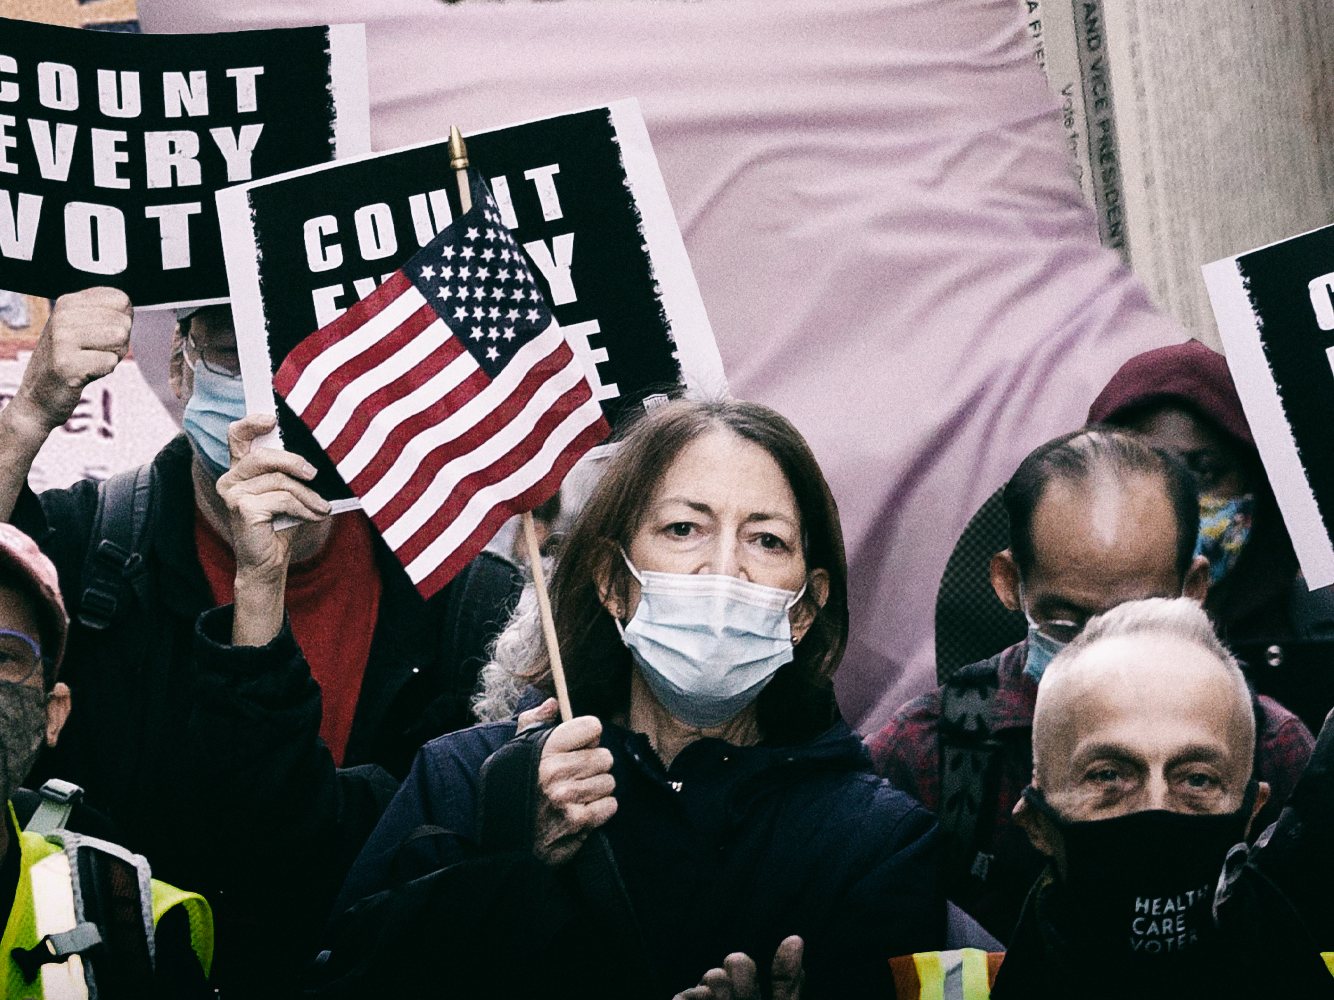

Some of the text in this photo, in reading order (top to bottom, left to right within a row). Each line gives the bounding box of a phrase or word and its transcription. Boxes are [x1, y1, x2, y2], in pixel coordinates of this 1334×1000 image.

[1082, 2, 1103, 52] AND
[1088, 56, 1112, 108] VICE
[1095, 118, 1126, 251] PRESIDENT
[1130, 929, 1198, 954] VOTER
[1132, 914, 1186, 936] CARE
